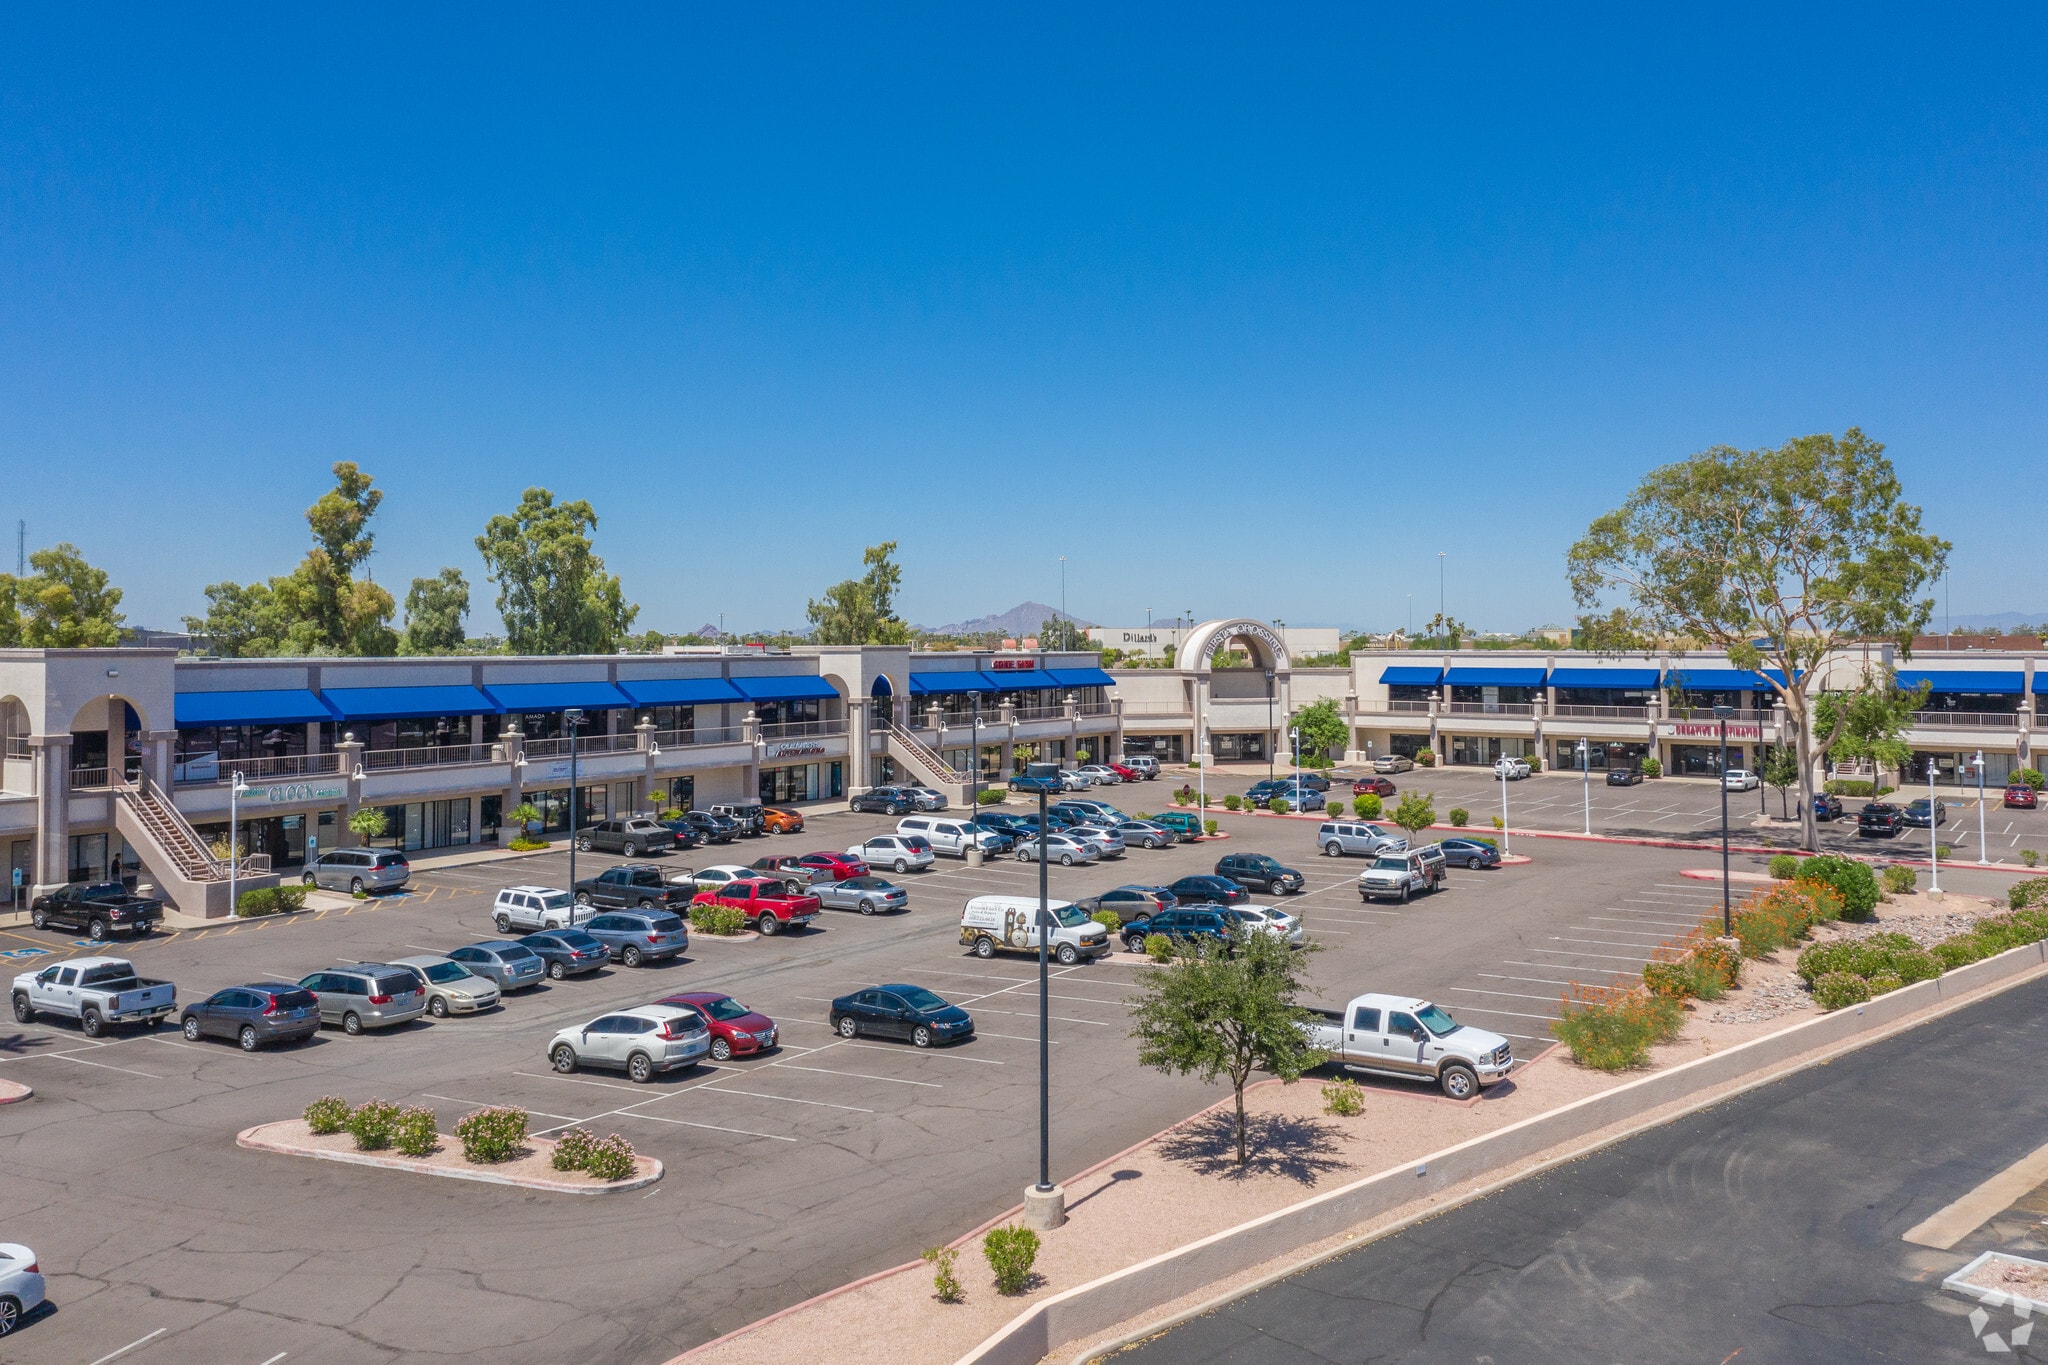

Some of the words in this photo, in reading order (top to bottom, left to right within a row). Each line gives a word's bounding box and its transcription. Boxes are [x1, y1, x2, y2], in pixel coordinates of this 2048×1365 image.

[1123, 632, 1157, 643] Dillard's
[1675, 724, 1712, 737] CREATIVE
[268, 784, 314, 802] CLOCK
